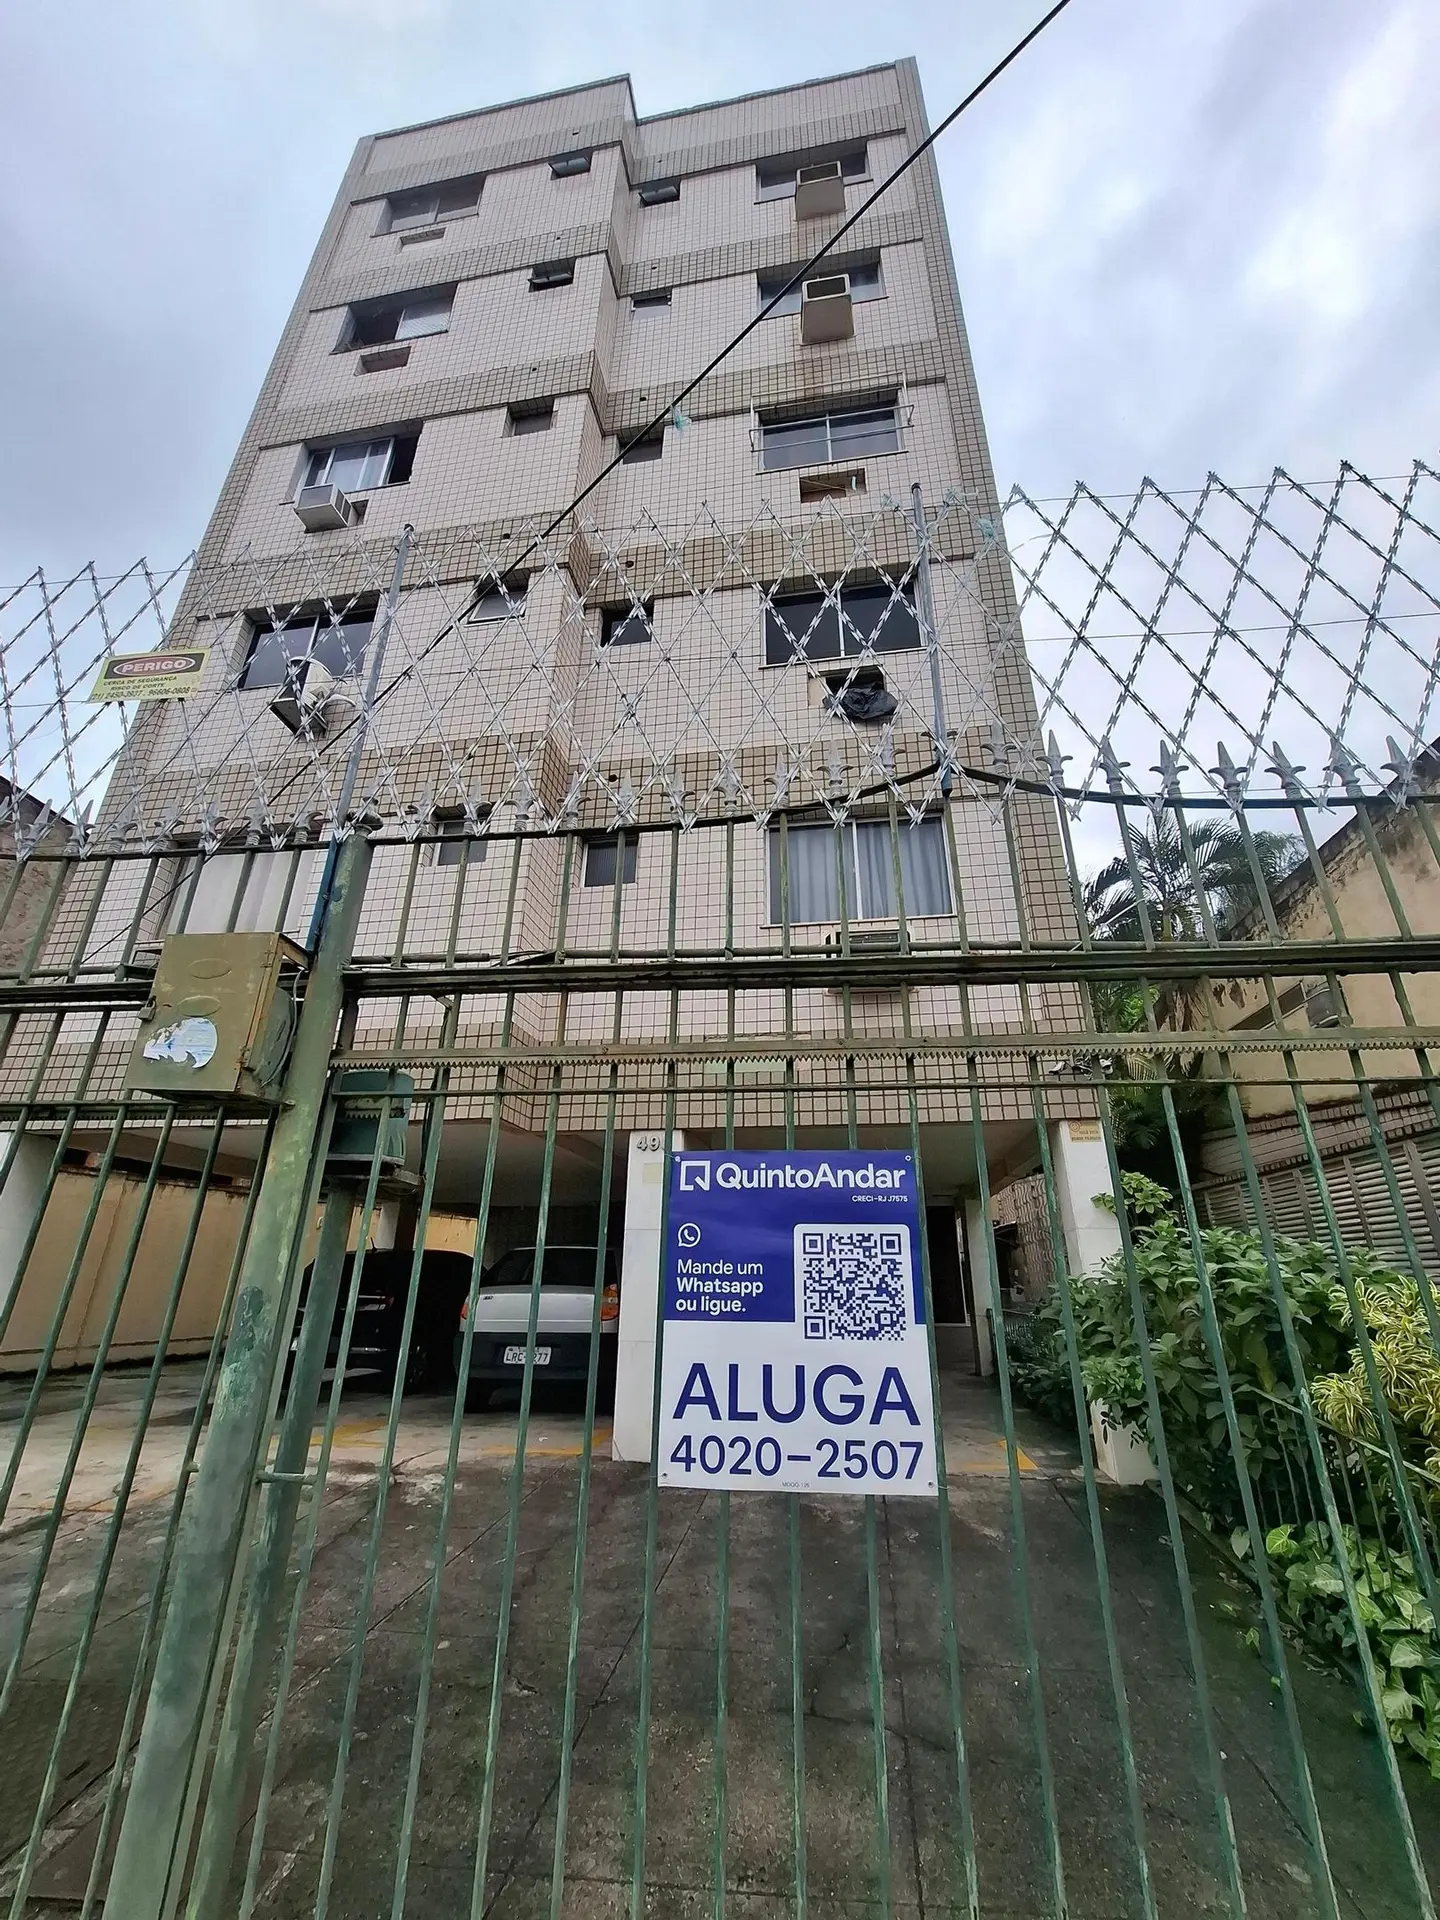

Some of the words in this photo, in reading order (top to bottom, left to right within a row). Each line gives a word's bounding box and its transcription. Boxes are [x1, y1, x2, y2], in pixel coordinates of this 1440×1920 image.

[121, 660, 187, 673] PERIGO
[138, 676, 177, 684] SEGURANÇA
[715, 1162, 906, 1191] QuintoAndar
[851, 1194, 887, 1203] CRECI-RJ
[887, 1194, 908, 1203] J7575
[677, 1259, 734, 1275] Mande
[737, 1263, 763, 1275] um
[676, 1277, 763, 1297] Whatsapp
[675, 1299, 697, 1312] ou
[700, 1296, 746, 1316] ligue.
[672, 1363, 921, 1426] ALUGA
[670, 1435, 924, 1480] 4020-2507
